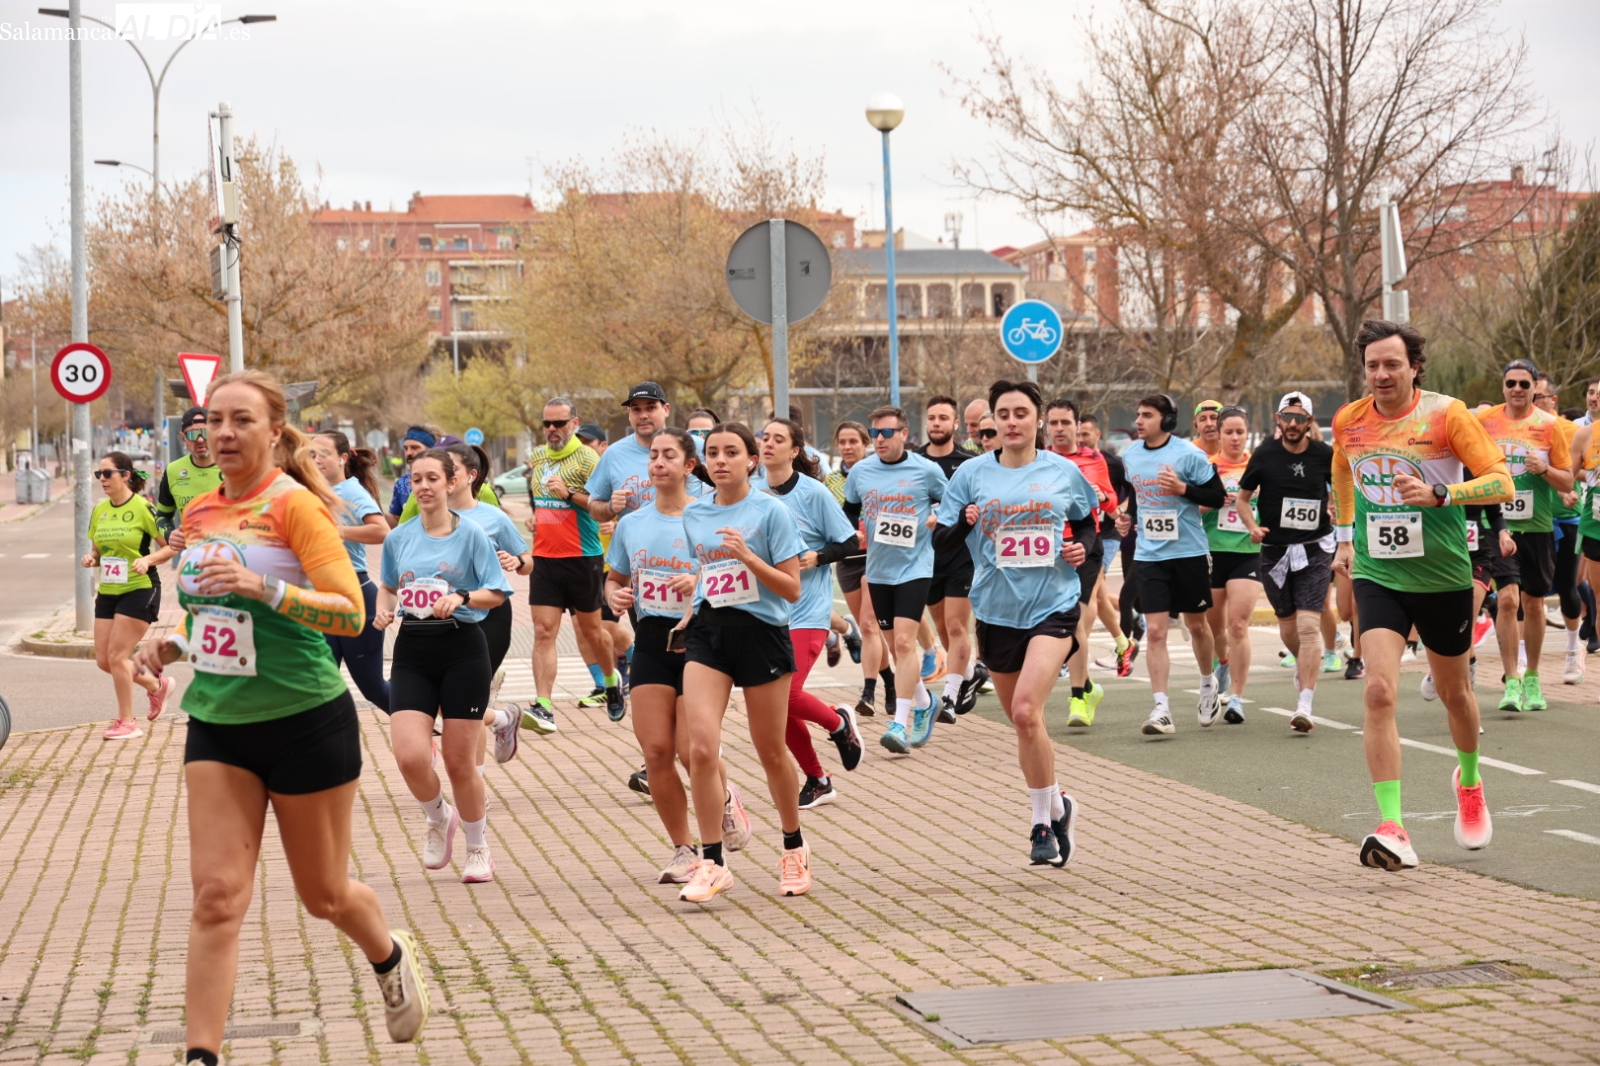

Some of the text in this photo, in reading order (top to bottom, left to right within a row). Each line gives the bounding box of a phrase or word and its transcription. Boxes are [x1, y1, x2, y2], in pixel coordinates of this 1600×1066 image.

[65, 364, 97, 383] 30
[880, 492, 915, 503] contra
[1455, 479, 1507, 501] ALCER
[1003, 500, 1053, 516] contra
[1285, 507, 1317, 522] 450
[1504, 500, 1526, 512] 59
[878, 521, 913, 538] 296
[1145, 518, 1175, 532] 435
[1379, 526, 1410, 546] 58
[1000, 536, 1051, 557] 219
[104, 564, 121, 576] 74
[648, 555, 694, 571] contra
[706, 570, 750, 597] 221
[401, 589, 443, 608] 209
[201, 624, 238, 657] 52
